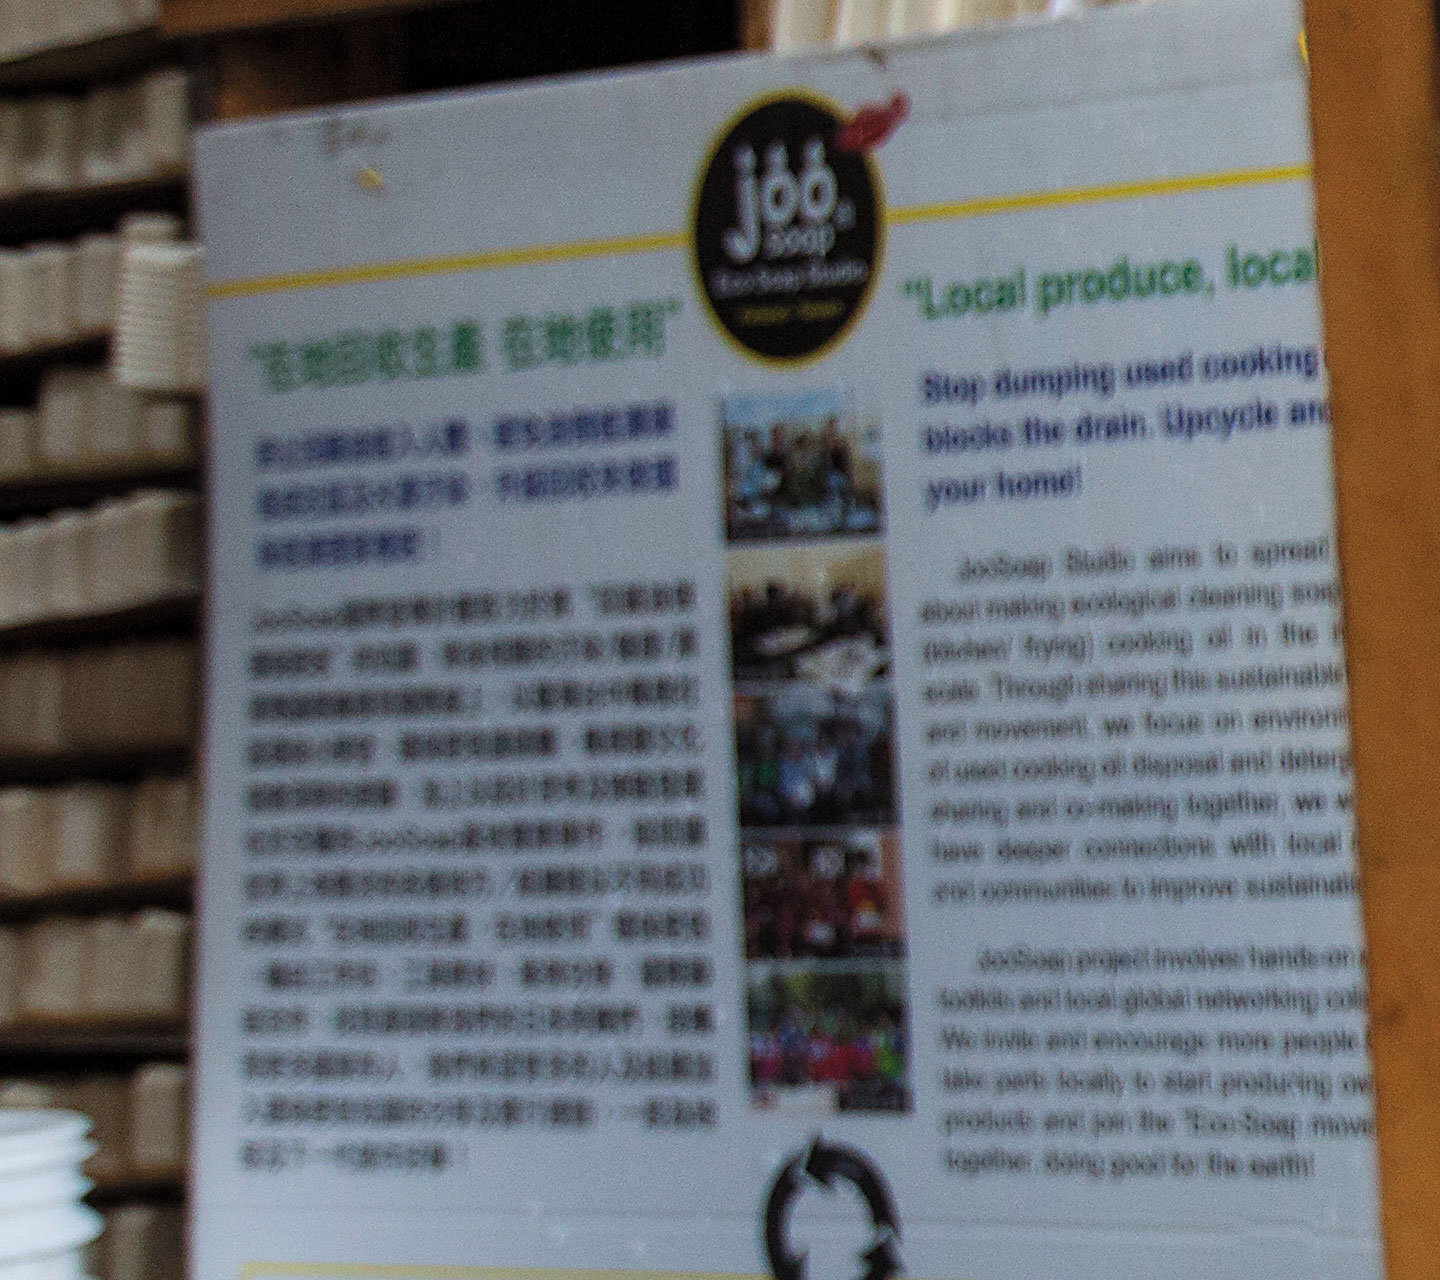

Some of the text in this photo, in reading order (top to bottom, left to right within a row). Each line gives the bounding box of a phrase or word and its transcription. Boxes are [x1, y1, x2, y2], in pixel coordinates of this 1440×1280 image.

[1036, 254, 1215, 319] produce,
[923, 343, 1319, 405] Stop dumping used cooking
[1024, 417, 1064, 447] the
[1160, 397, 1276, 444] Upcycle
[925, 476, 986, 512] your
